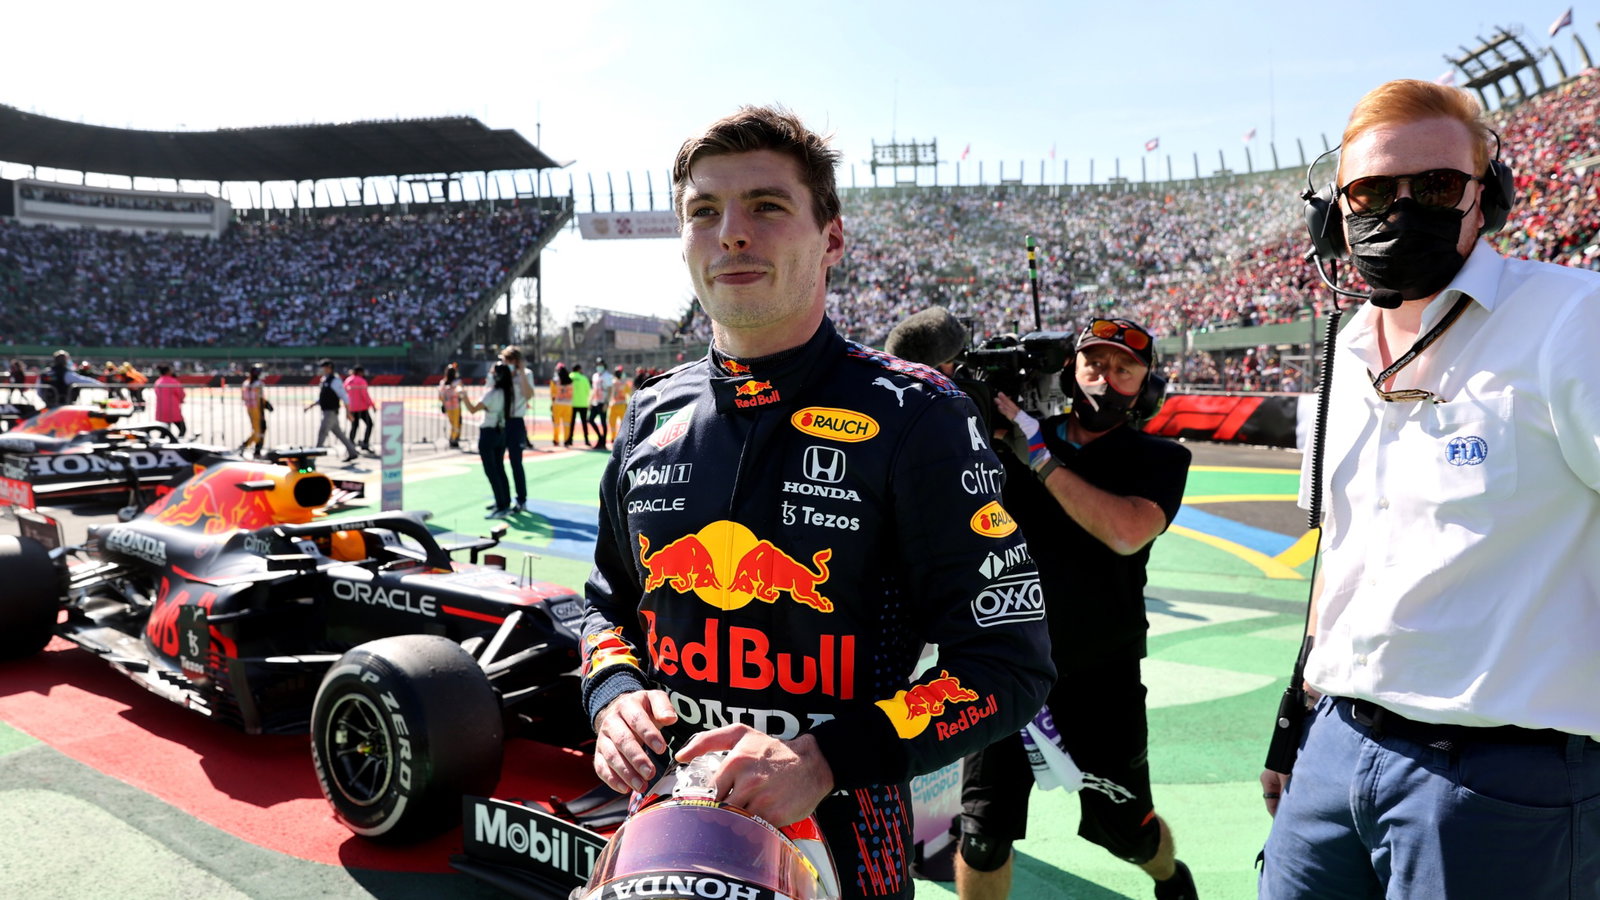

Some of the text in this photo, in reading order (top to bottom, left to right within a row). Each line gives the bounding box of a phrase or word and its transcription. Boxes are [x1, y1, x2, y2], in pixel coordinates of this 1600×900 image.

[734, 390, 781, 409] Red Bull
[813, 415, 869, 436] RAUCH
[382, 425, 403, 466] 3
[627, 465, 685, 488] Mobil 1
[627, 497, 686, 514] ORACLE
[782, 481, 862, 502] HONDA
[802, 506, 860, 531] Tezos
[990, 511, 1012, 528] RAU
[106, 527, 168, 560] HONDA
[244, 534, 272, 554] citrix
[333, 579, 437, 617] ORACLE
[975, 583, 1043, 616] OXXO
[729, 626, 855, 700] Bull
[650, 681, 836, 741] OND
[936, 694, 998, 741] Red Bull
[361, 671, 412, 792] P ZERO
[475, 803, 569, 873] Mobil
[612, 875, 761, 900] HONDA
